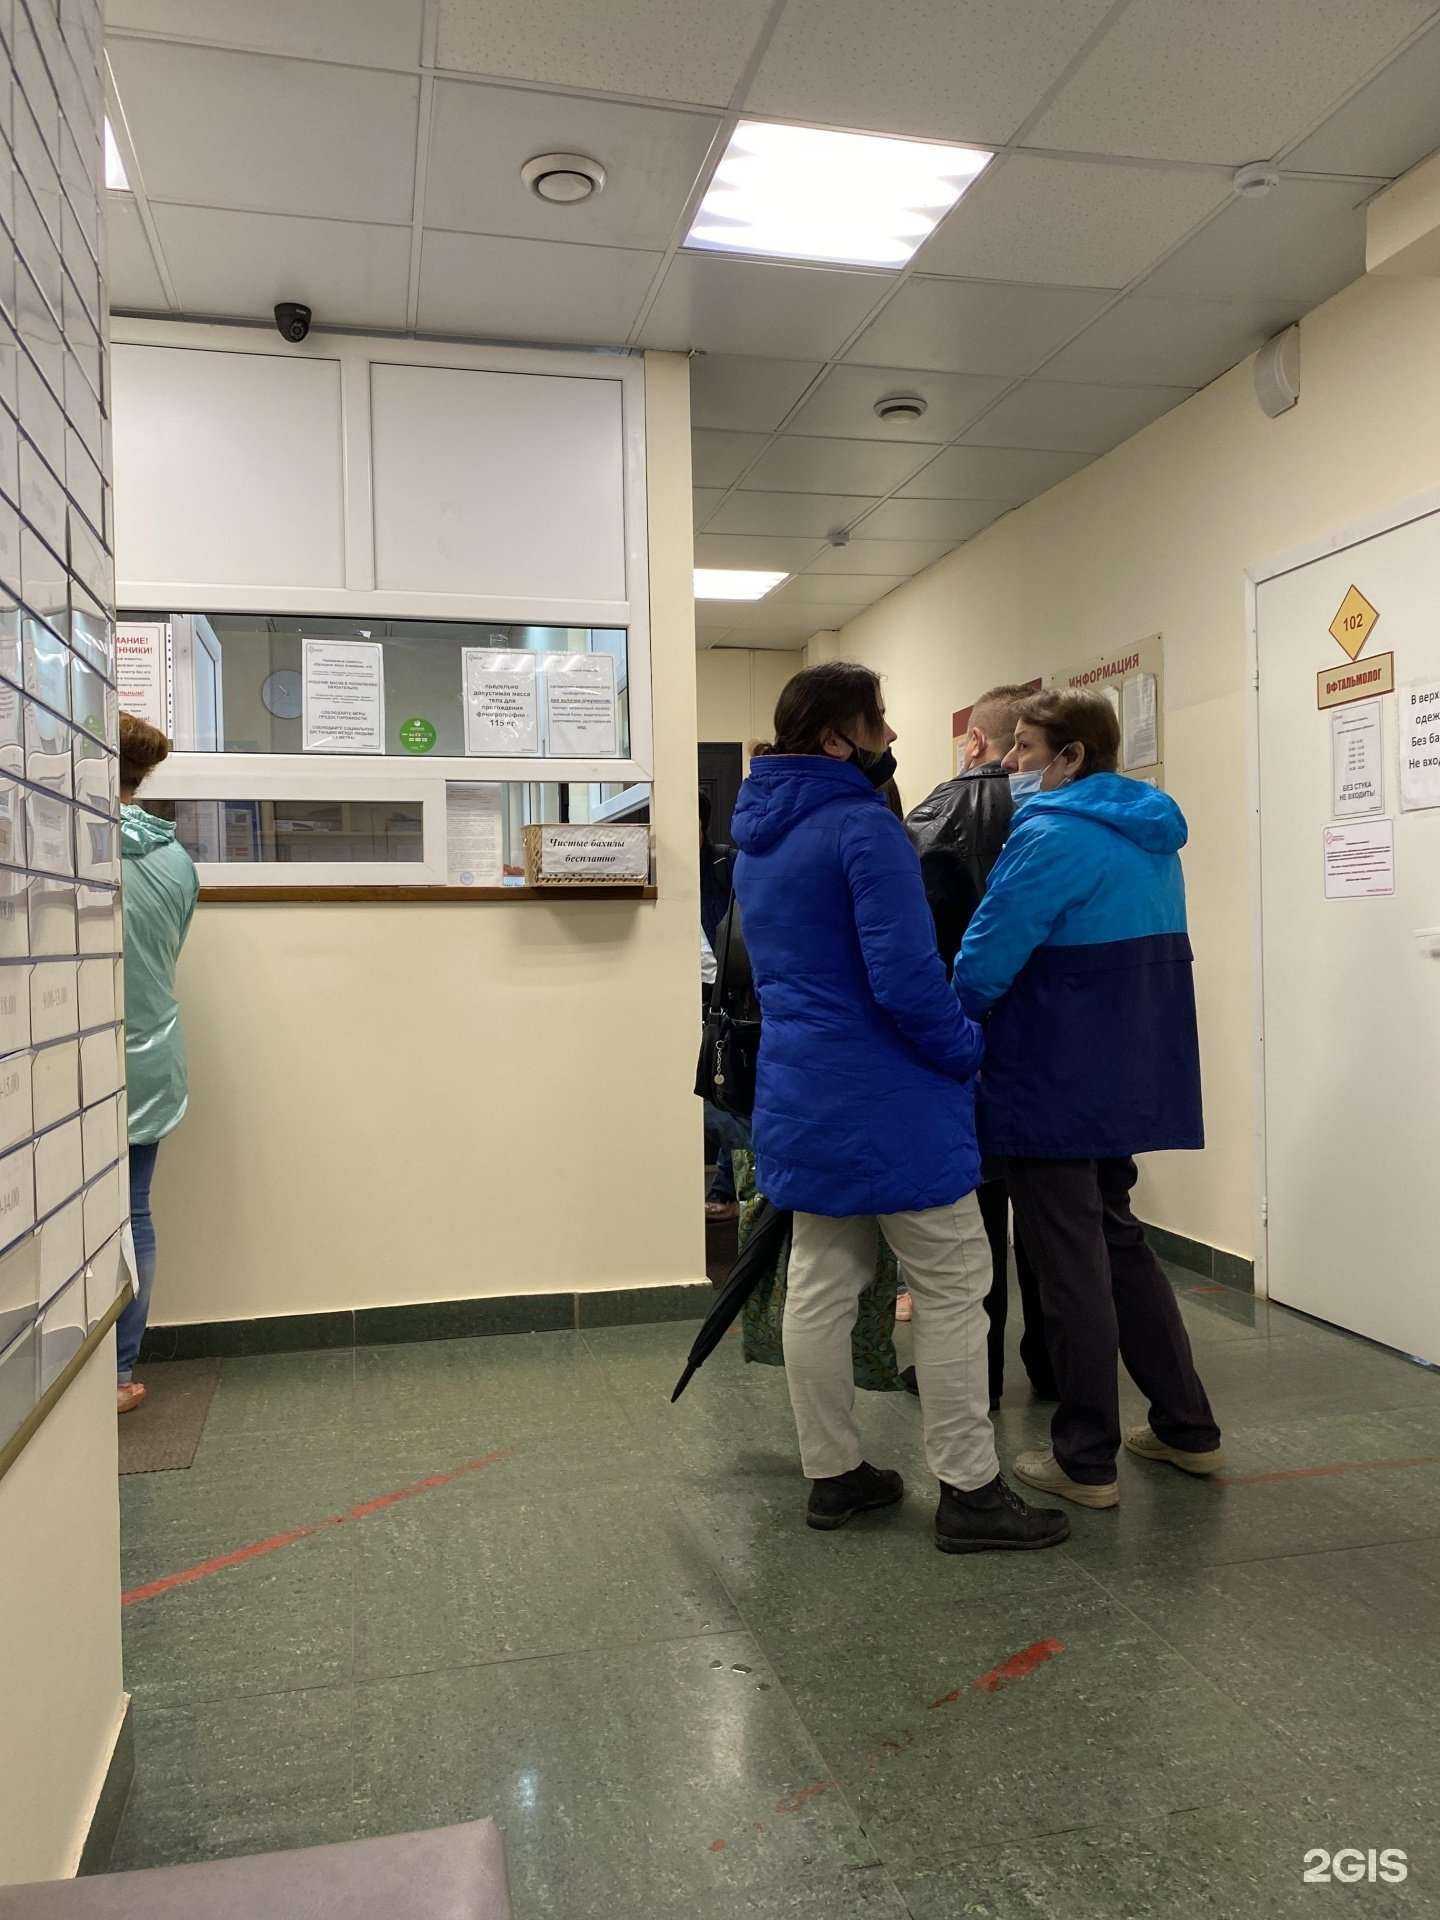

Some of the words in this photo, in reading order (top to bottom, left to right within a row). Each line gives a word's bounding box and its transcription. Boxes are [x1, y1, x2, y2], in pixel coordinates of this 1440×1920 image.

[1343, 613, 1364, 631] 102
[1069, 653, 1140, 689] ИНФОРМАЦИЯ
[1326, 668, 1382, 694] ОФТАЛЬМОЛОГ
[1411, 694, 1417, 705] В
[1411, 736, 1427, 747] Без
[1429, 733, 1440, 744] ба
[1409, 759, 1420, 769] Не
[550, 838, 588, 848] Чистые
[590, 839, 625, 848] бахилы
[565, 854, 616, 863] бесплатно
